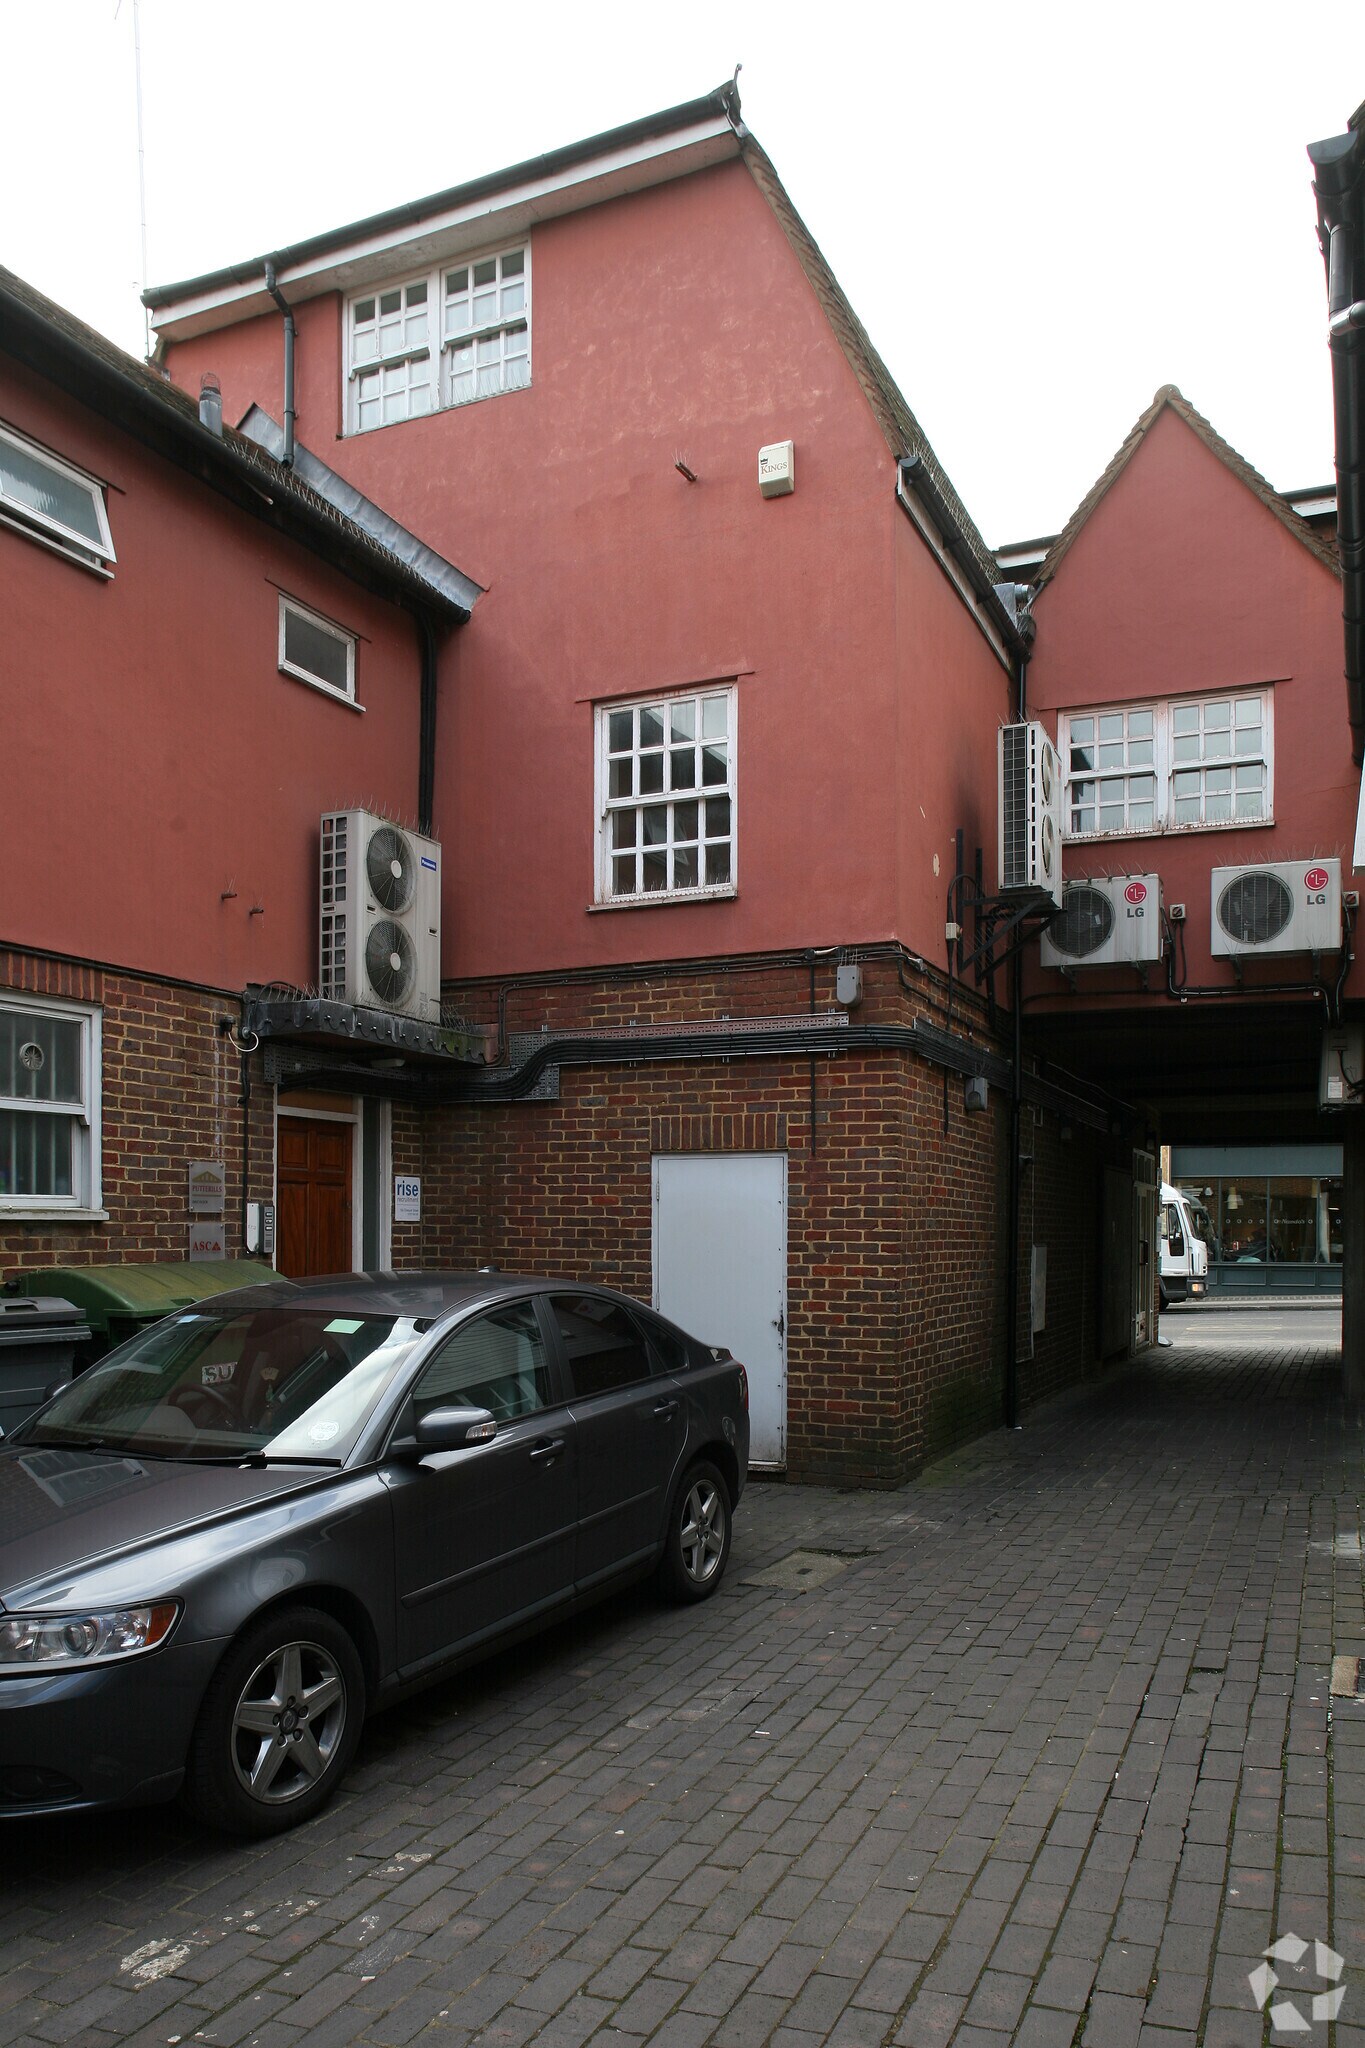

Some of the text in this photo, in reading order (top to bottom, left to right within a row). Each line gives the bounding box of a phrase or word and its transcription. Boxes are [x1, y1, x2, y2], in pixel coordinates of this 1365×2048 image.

[1307, 894, 1326, 905] LG
[1127, 907, 1145, 918] LG
[397, 1180, 419, 1197] rise
